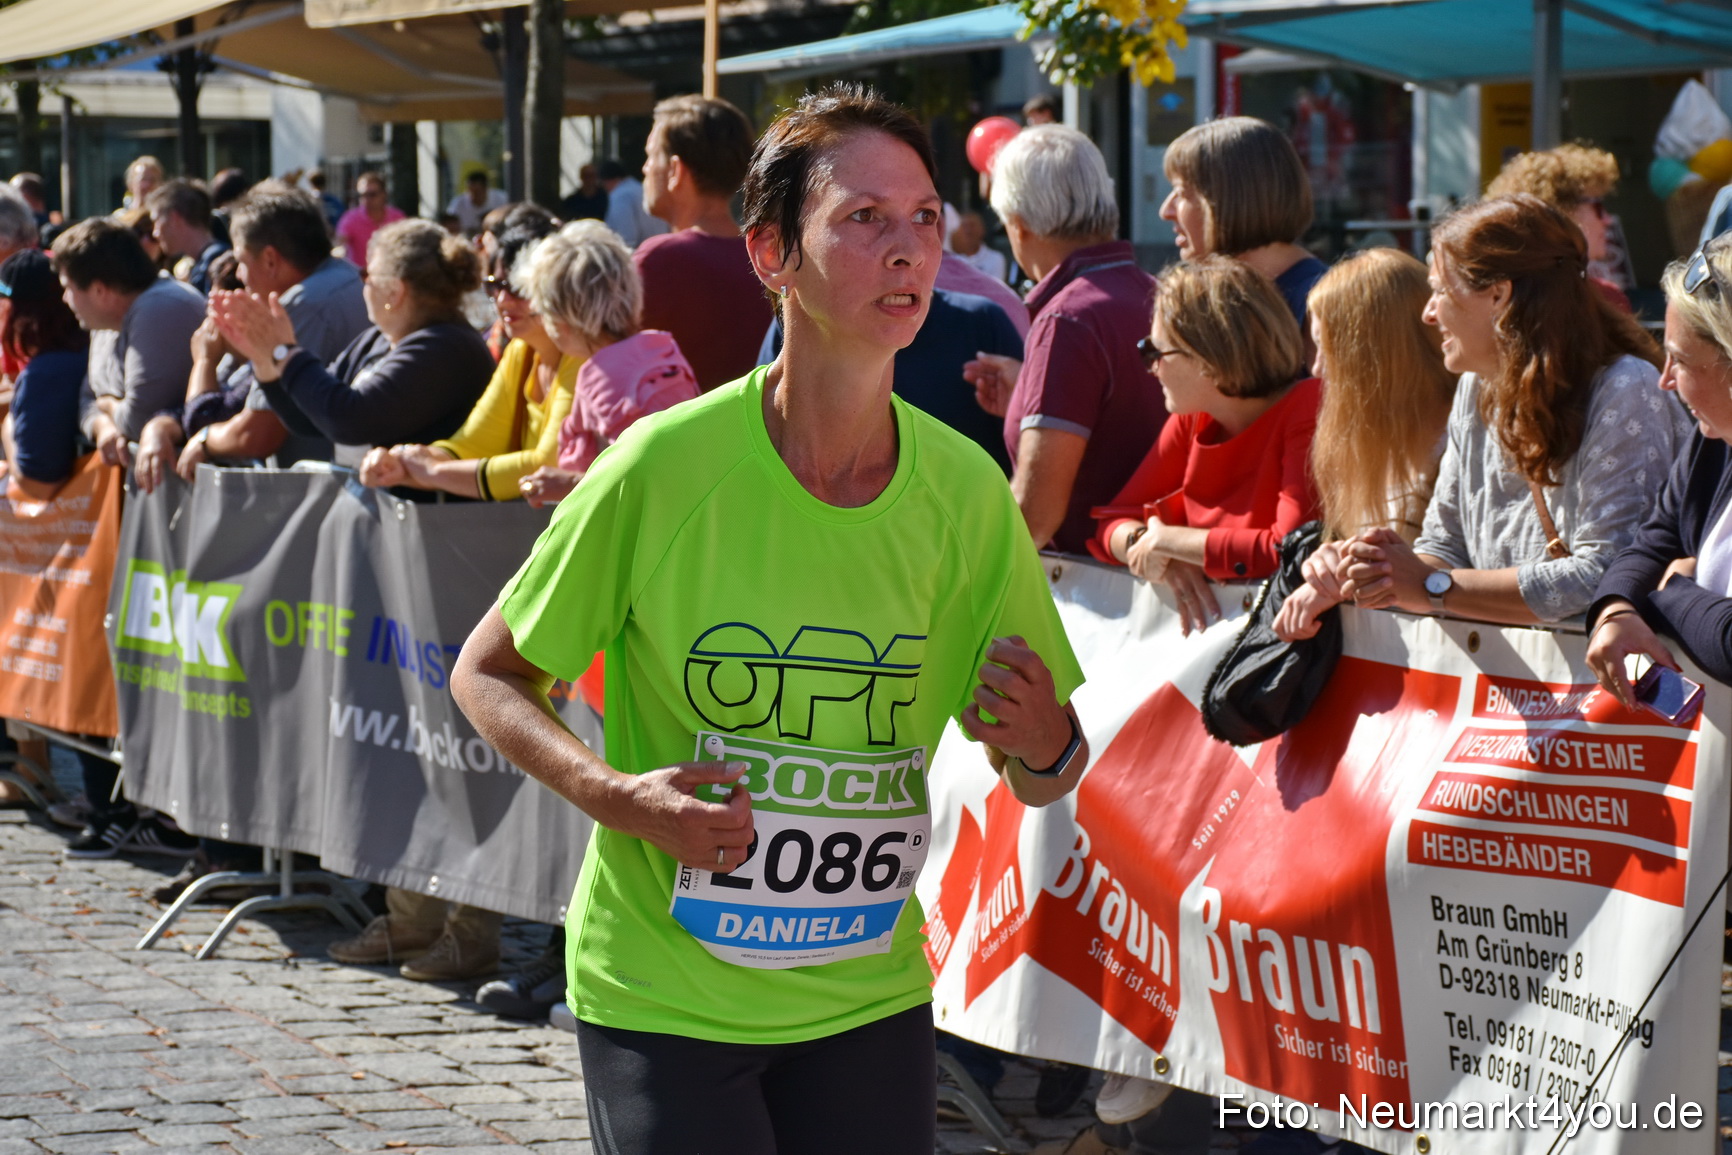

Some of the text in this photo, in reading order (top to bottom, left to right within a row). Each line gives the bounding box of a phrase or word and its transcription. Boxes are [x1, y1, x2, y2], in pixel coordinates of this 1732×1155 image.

[711, 745, 917, 811] BOCK
[1430, 779, 1629, 827] RUNDSCHLINGEN
[912, 834, 922, 846] D
[1192, 789, 1240, 850] Seit 1929
[679, 865, 693, 890] ZEIT
[710, 828, 907, 894] 2086
[1422, 831, 1592, 877] HEBEBÄNDER
[716, 912, 865, 943] DANIELA
[1042, 820, 1172, 987] Braun
[1431, 895, 1568, 939] Braun GmbH
[1088, 937, 1179, 1022] Sicher ist sicher
[1185, 884, 1382, 1035] Braun
[1437, 929, 1583, 982] Am Grünberg 8
[1439, 963, 1654, 1049] D-92318 Neumarkt-Pölling
[1274, 1023, 1409, 1080] Sicher ist sicher
[1444, 1011, 1481, 1042] Tel.
[1486, 1019, 1534, 1055] 09181
[1550, 1035, 1596, 1076] 2307-0
[1449, 1045, 1482, 1077] Fax
[1488, 1054, 1531, 1091] 09181
